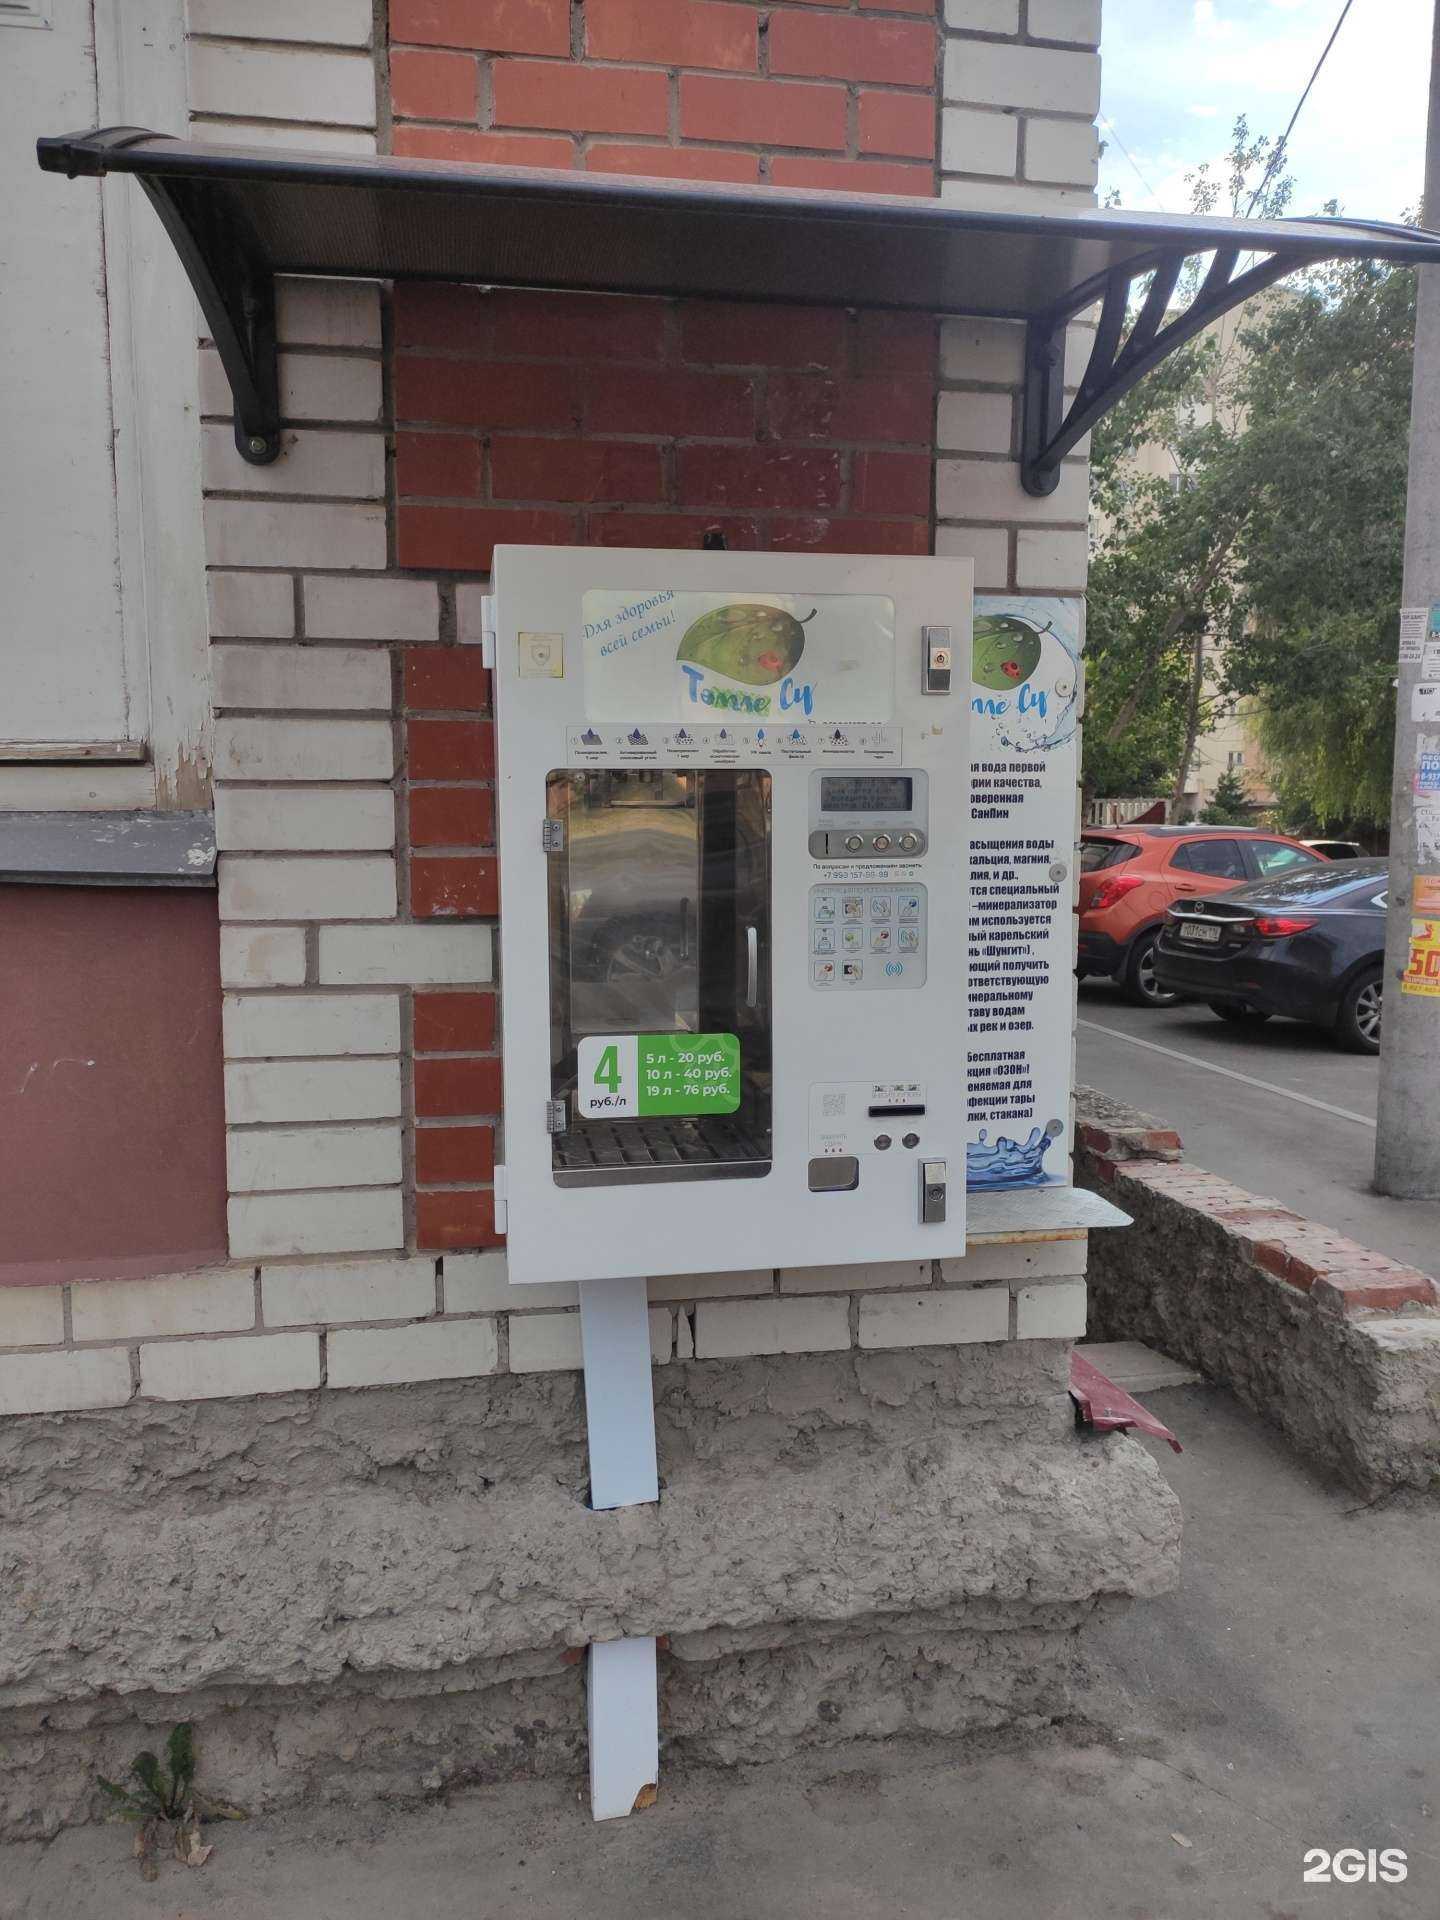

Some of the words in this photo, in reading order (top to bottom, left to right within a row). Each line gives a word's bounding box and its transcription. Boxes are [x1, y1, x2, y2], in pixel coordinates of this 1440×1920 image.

[582, 619, 612, 640] Для
[615, 590, 674, 624] здоровья
[600, 633, 628, 656] всей
[631, 610, 676, 641] семьи!
[982, 763, 1007, 774] вода
[1009, 761, 1046, 773] первой
[970, 779, 991, 789] рии
[993, 778, 1042, 789] качества,
[971, 808, 1009, 819] СанПин
[969, 840, 1024, 851] асыщения
[1026, 839, 1054, 849] воды
[1013, 854, 1052, 864] магния,
[993, 871, 1000, 880] и
[989, 883, 1060, 896] специальный
[982, 915, 1051, 926] используется
[988, 928, 1049, 941] карельский
[969, 960, 1001, 972] ющий
[1002, 961, 1050, 971] получить
[968, 976, 1049, 987] ответствующую
[968, 1008, 991, 1017] таву
[992, 1006, 1025, 1017] водам
[980, 1022, 998, 1033] рек
[999, 1022, 1006, 1031] и
[1008, 1021, 1034, 1031] озер.
[646, 1053, 655, 1064] 5
[657, 1055, 666, 1064] л
[678, 1052, 694, 1063] 20
[697, 1051, 725, 1064] руб.
[593, 1045, 622, 1094] 4
[646, 1069, 660, 1080] 10
[663, 1071, 672, 1080] л
[683, 1068, 701, 1079] 40
[704, 1067, 732, 1080] руб.
[967, 1068, 991, 1078] кция
[646, 1085, 658, 1096] 19
[662, 1087, 672, 1096] л
[683, 1084, 699, 1095] 76
[702, 1083, 730, 1097] руб.
[967, 1081, 1011, 1092] еняемая
[1013, 1080, 1032, 1090] для
[590, 1096, 627, 1109] руб./л
[967, 1096, 1008, 1107] фекции
[1010, 1094, 1035, 1104] тары
[990, 1107, 1033, 1120] стакана)
